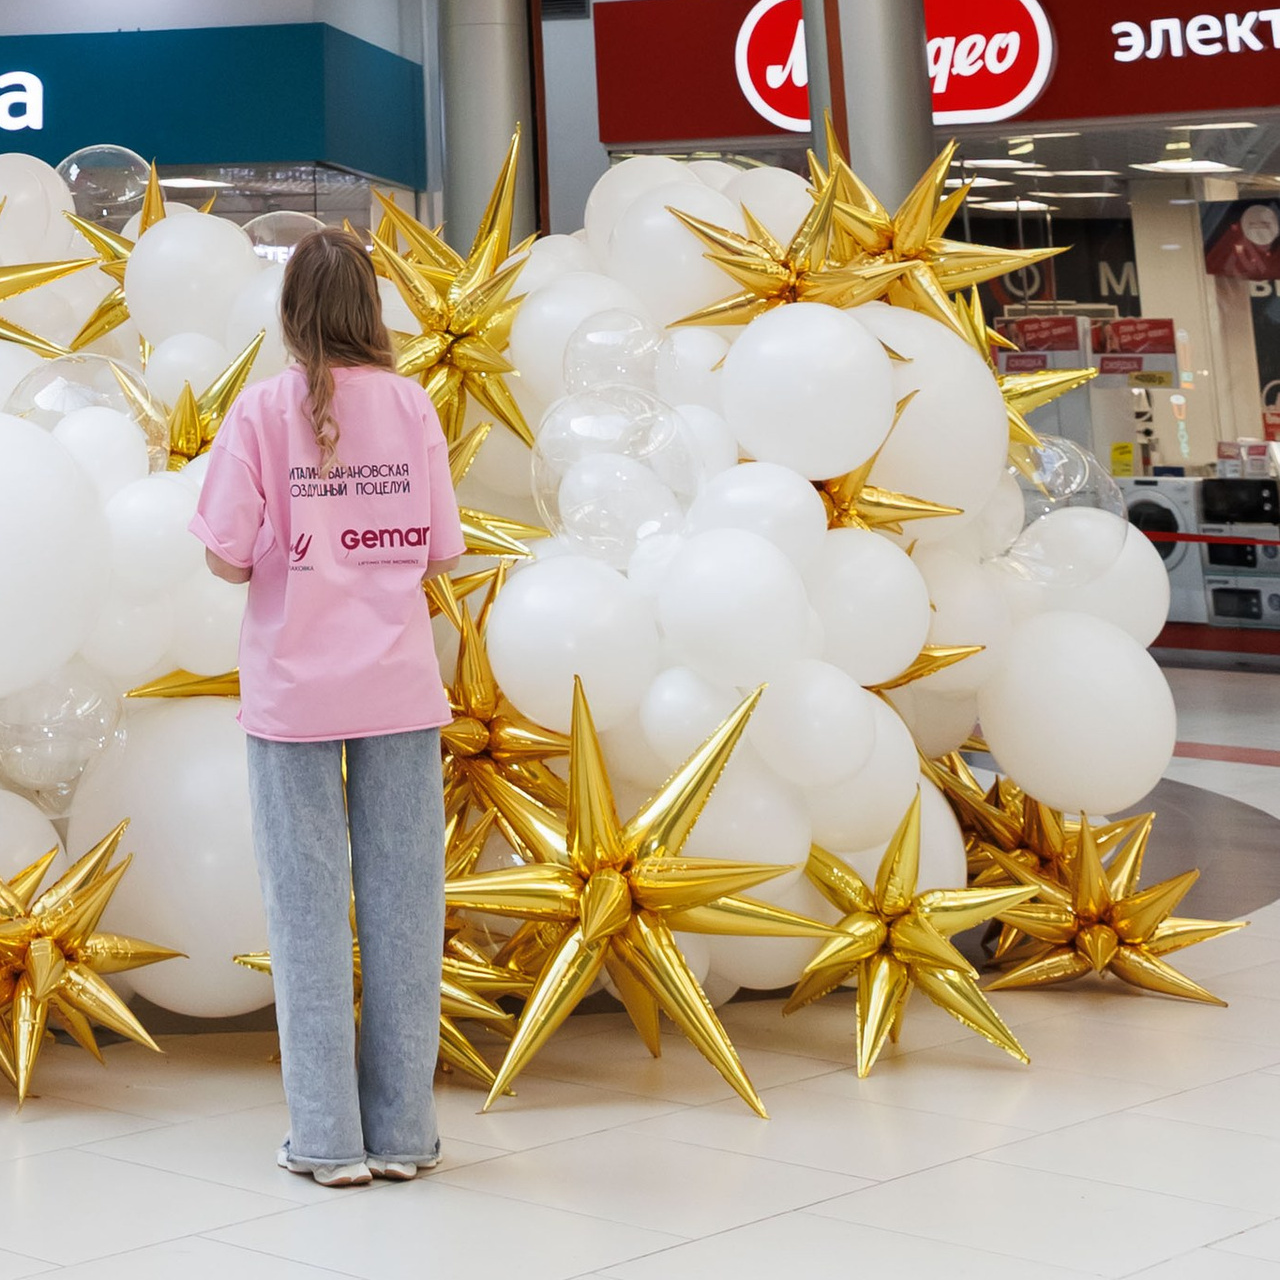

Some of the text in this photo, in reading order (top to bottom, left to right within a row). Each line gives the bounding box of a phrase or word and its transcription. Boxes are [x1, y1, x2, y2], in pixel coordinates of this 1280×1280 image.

[1111, 8, 1280, 63] элект
[289, 463, 410, 480] ИТАЛИН БАРАНОВСКАЯ
[355, 478, 411, 496] ПОЦЕЛУЙ
[340, 526, 430, 550] Gemar
